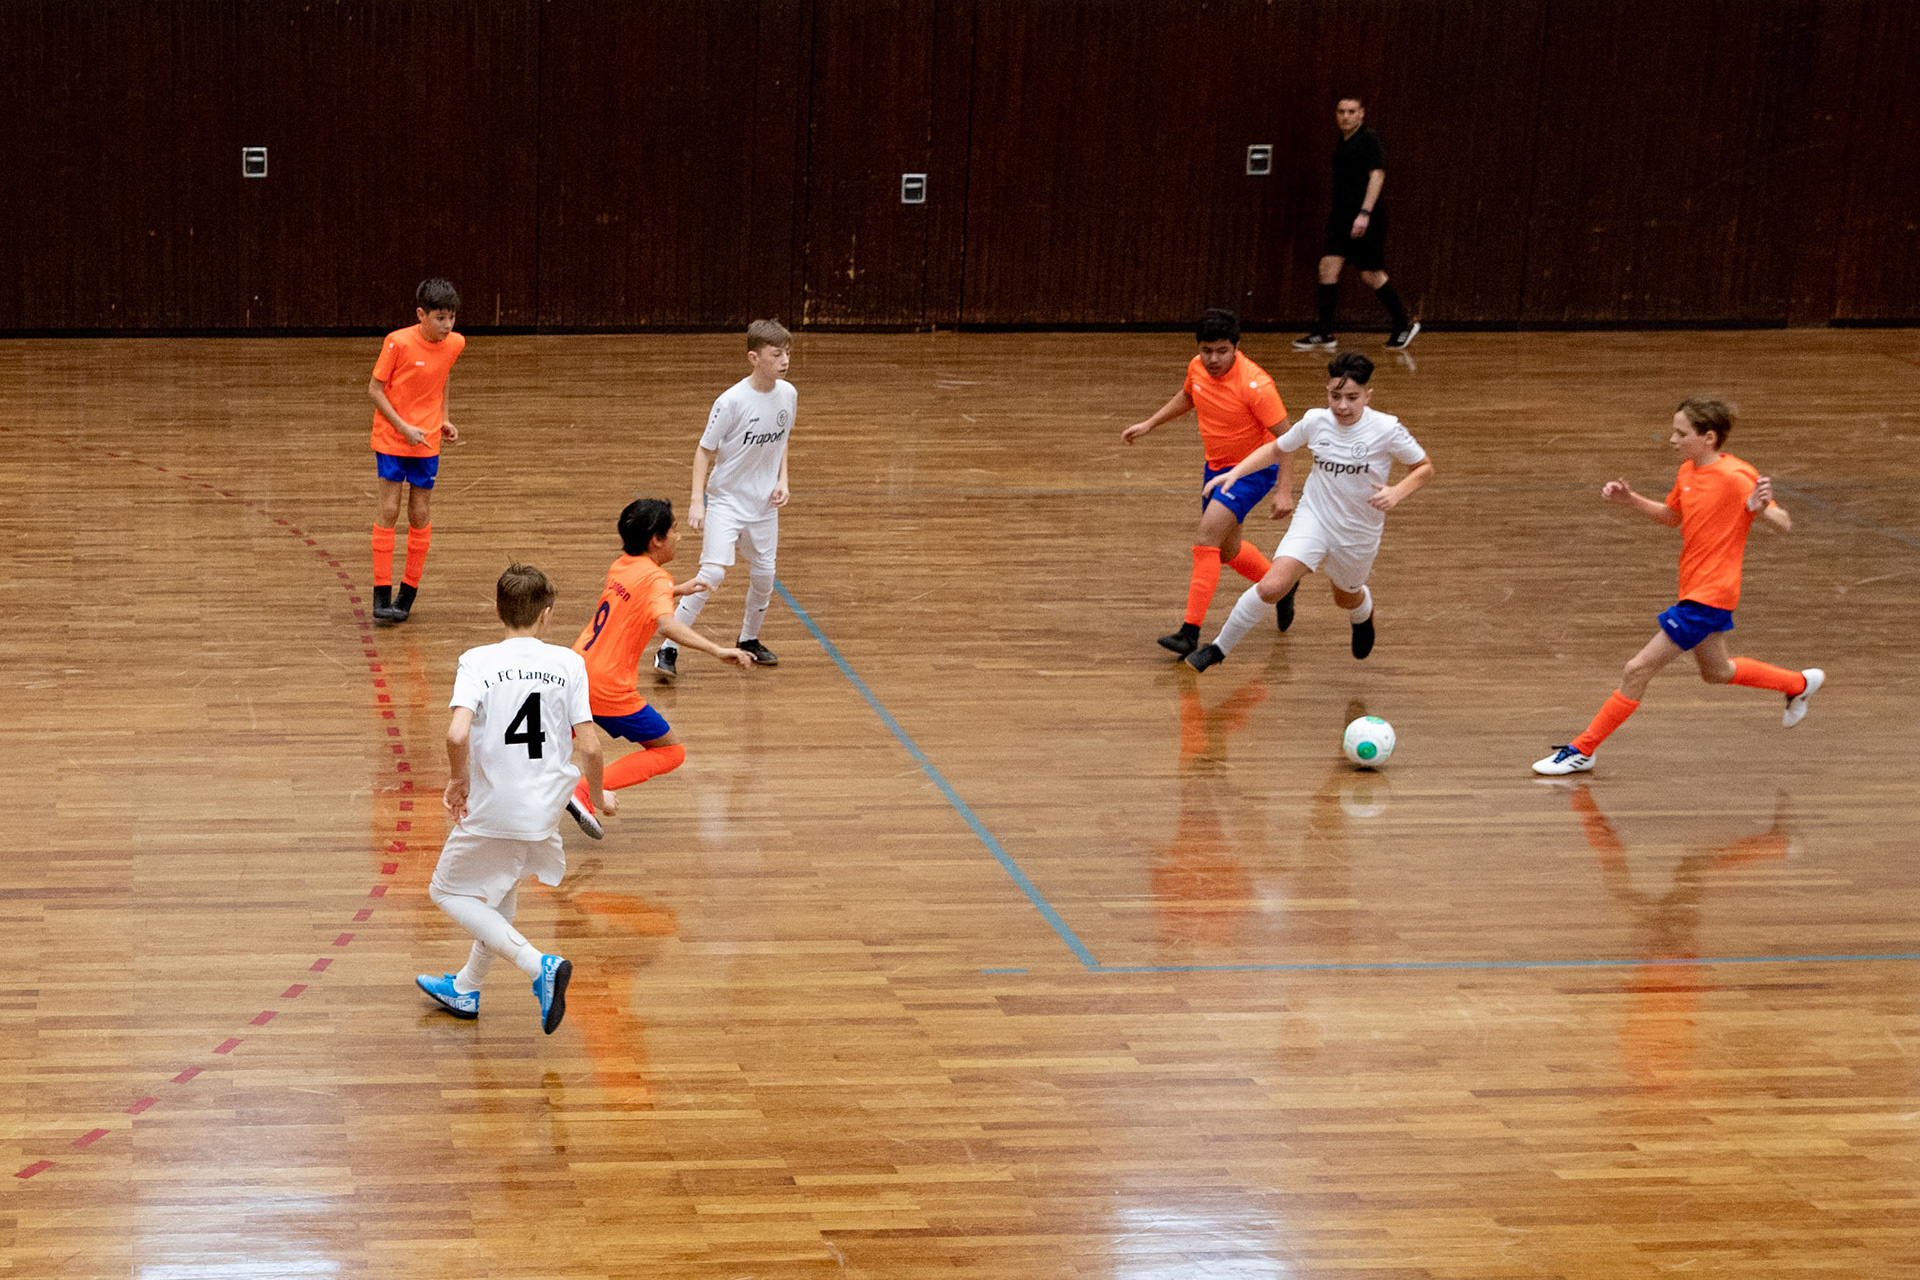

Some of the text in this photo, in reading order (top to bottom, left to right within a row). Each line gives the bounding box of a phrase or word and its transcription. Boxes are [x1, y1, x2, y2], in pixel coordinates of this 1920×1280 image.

[583, 600, 610, 651] 9
[497, 668, 514, 682] FC
[518, 669, 566, 687] Langen
[504, 692, 546, 760] 4
